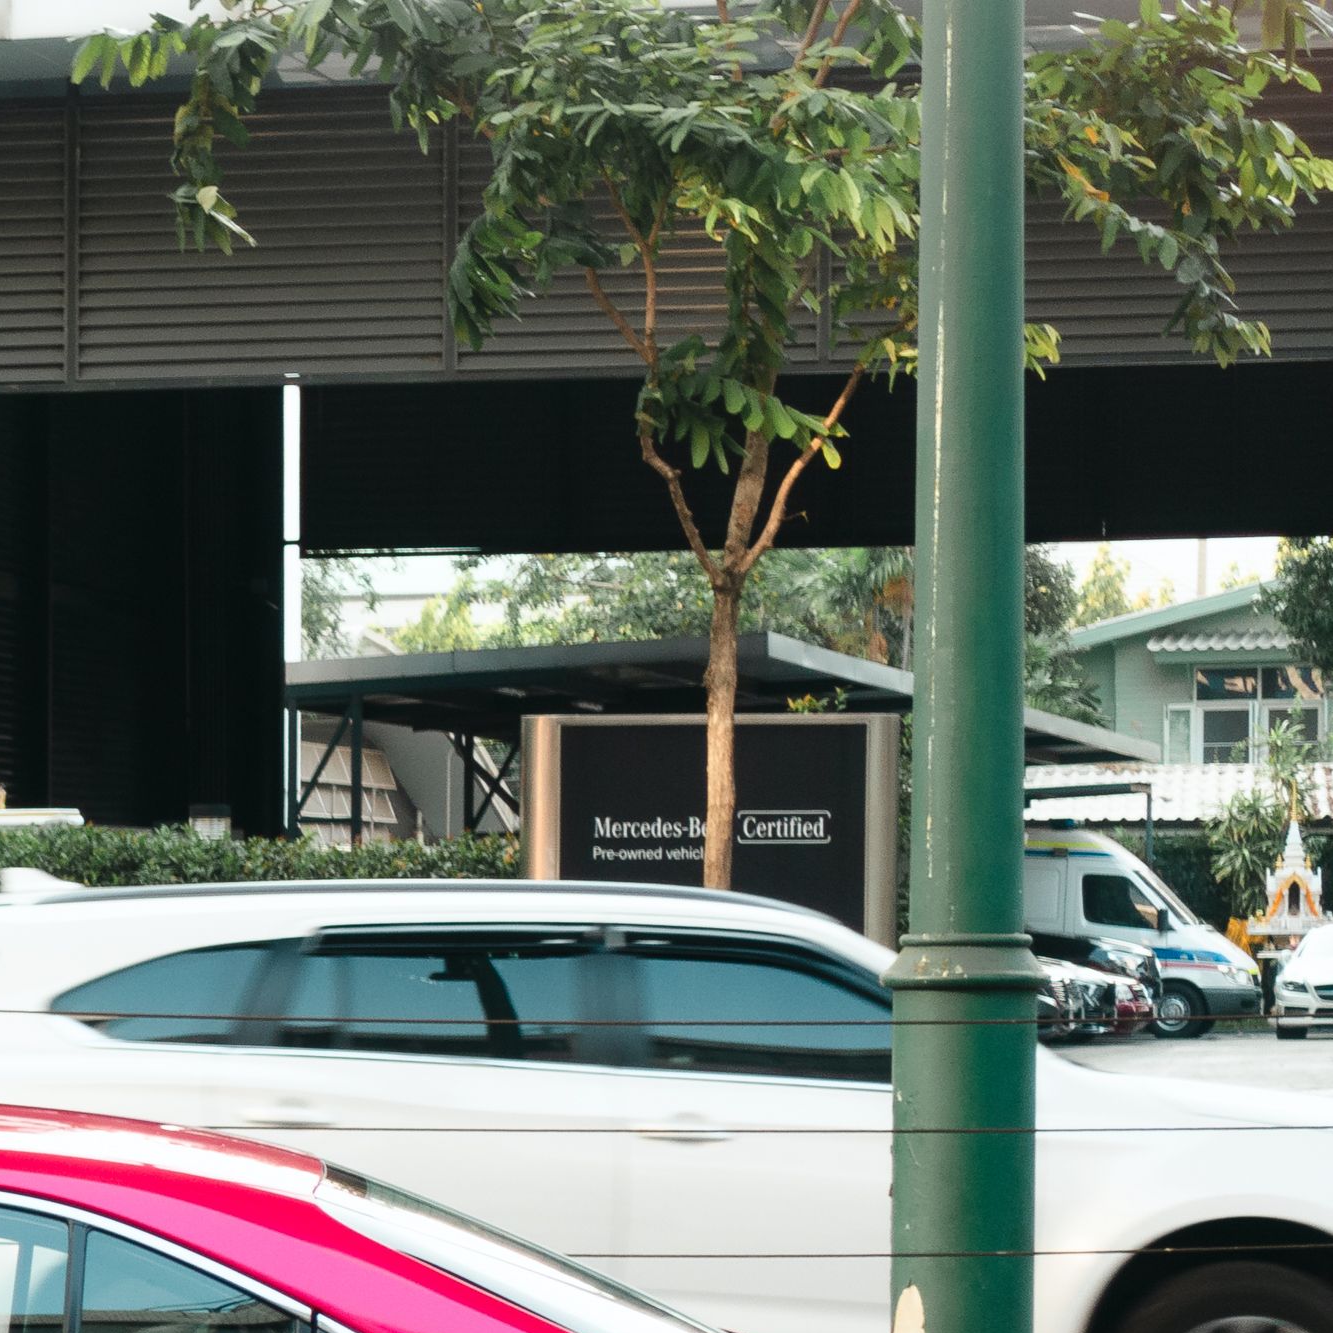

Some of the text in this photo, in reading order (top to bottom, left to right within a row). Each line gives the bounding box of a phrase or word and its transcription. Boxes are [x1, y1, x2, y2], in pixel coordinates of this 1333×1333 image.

[742, 816, 824, 839] Certified
[593, 845, 705, 860] Pre-owned vehicl
